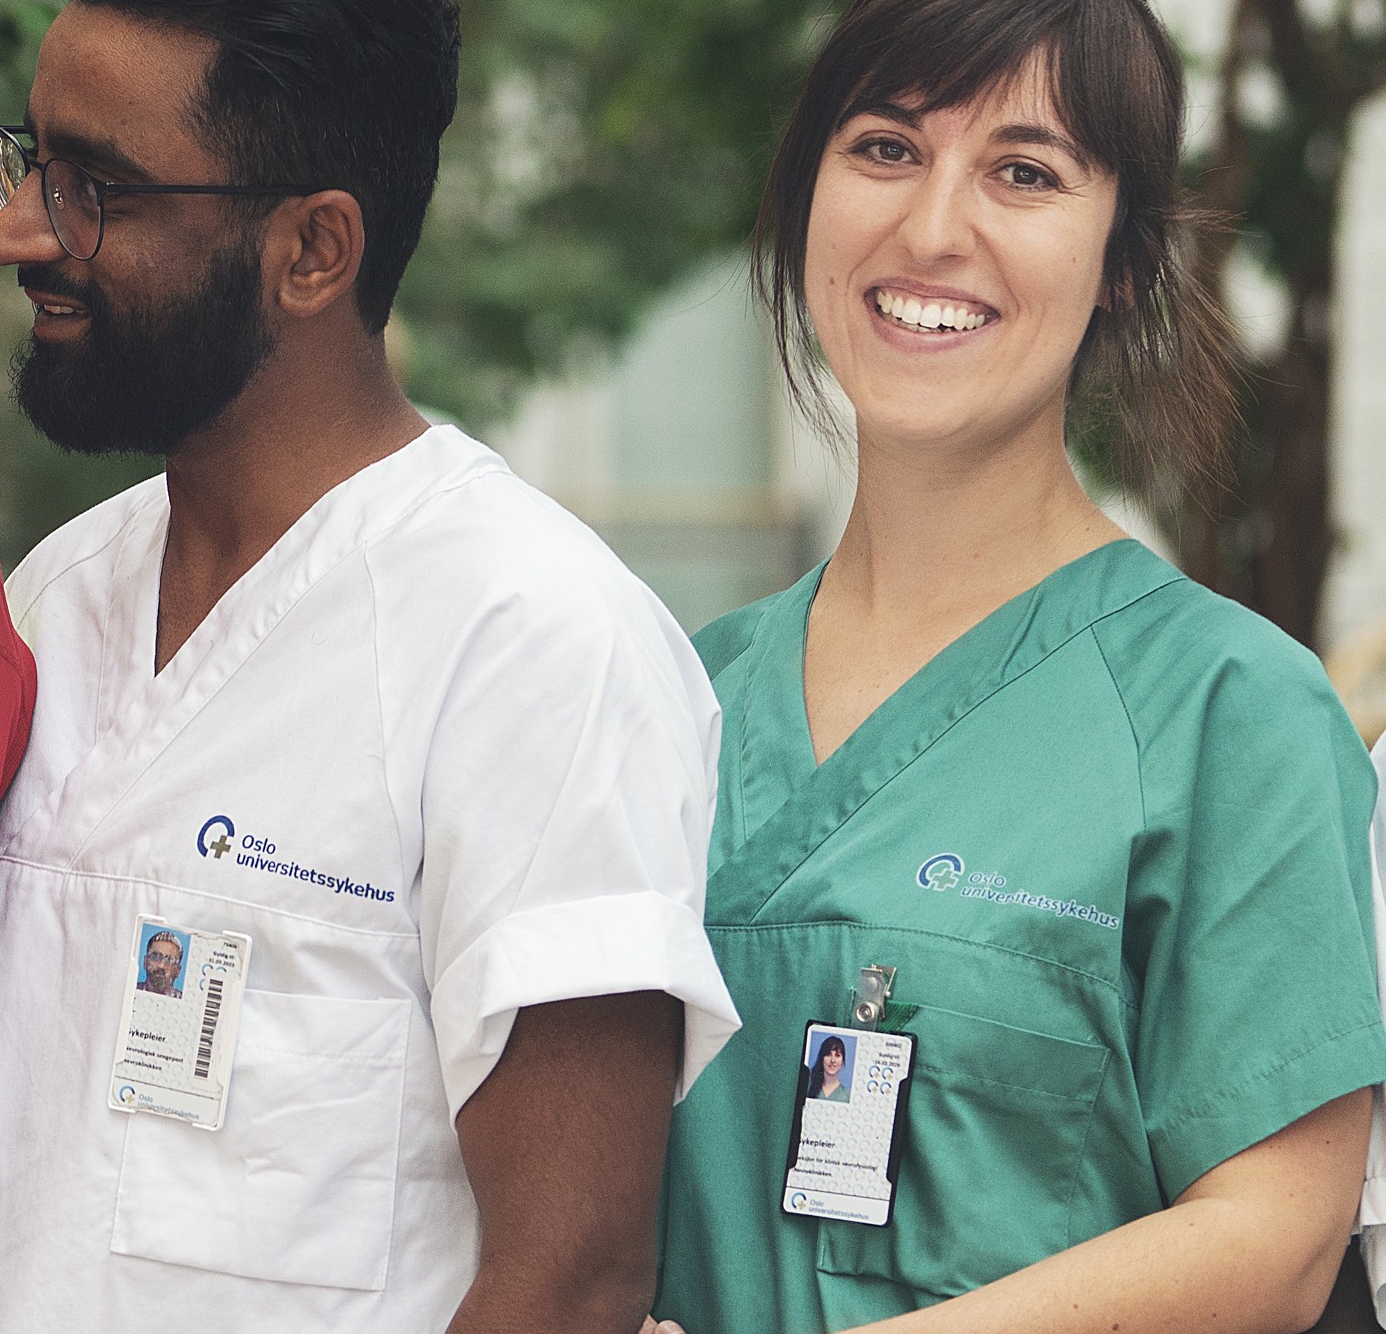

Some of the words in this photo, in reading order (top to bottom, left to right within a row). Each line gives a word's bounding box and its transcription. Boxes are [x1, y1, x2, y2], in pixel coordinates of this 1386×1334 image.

[241, 834, 276, 855] Oslo
[236, 853, 395, 903] universitetssykehus
[967, 871, 1006, 887] Oslo
[960, 885, 1121, 930] universitetssykehus
[809, 1198, 825, 1207] Oslo
